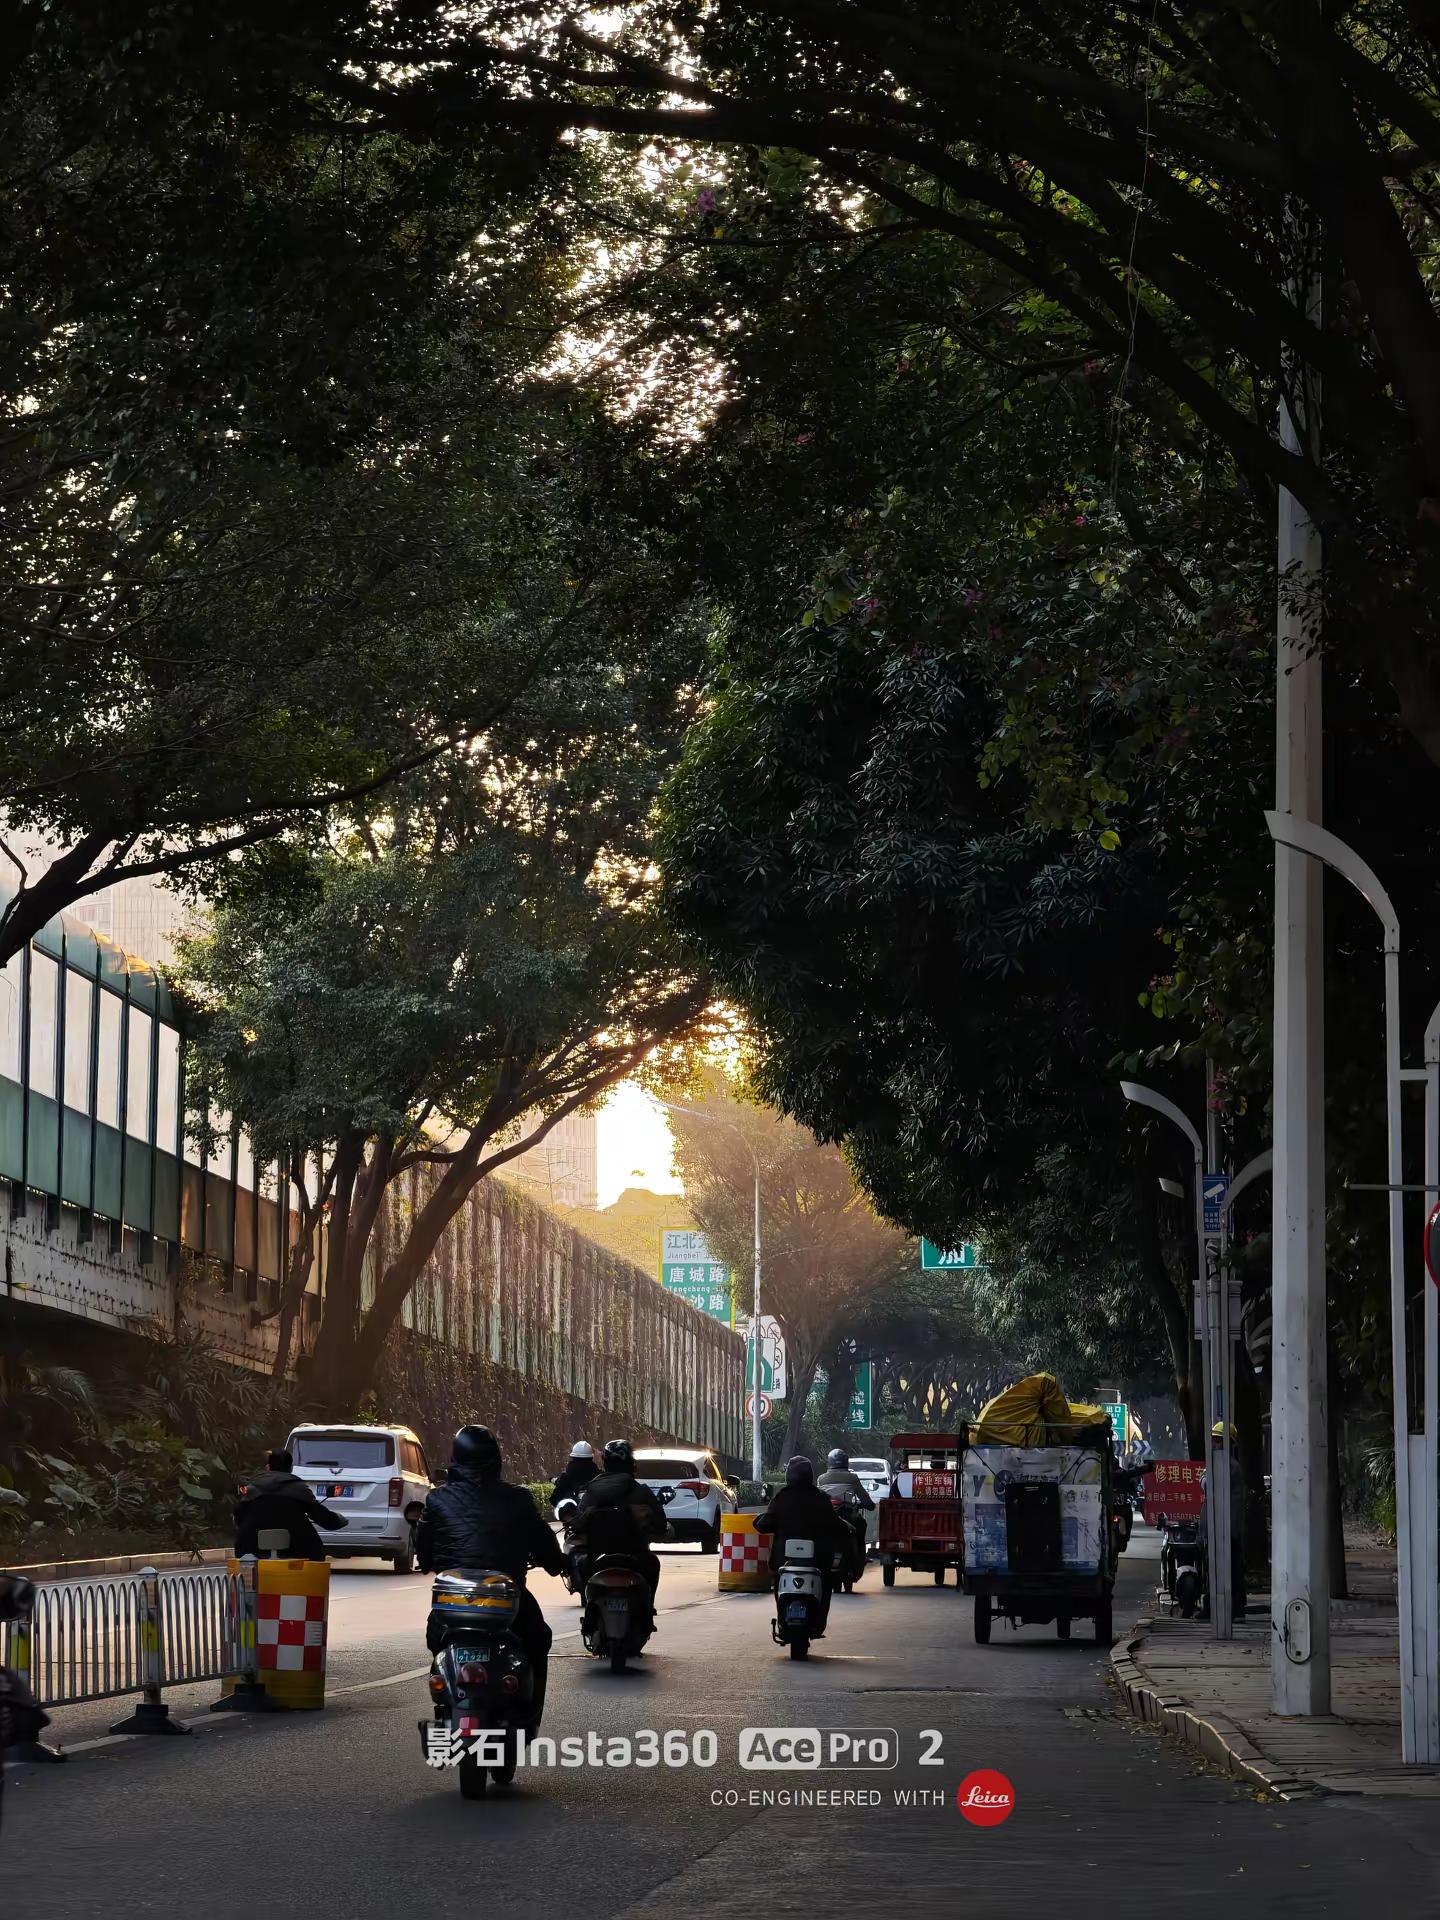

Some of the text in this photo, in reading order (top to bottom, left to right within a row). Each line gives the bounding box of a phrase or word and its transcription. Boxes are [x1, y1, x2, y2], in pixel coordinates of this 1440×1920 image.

[669, 1267, 724, 1282] 唐城路
[682, 1294, 724, 1310] 沙路
[915, 1476, 953, 1486] 作业车辆
